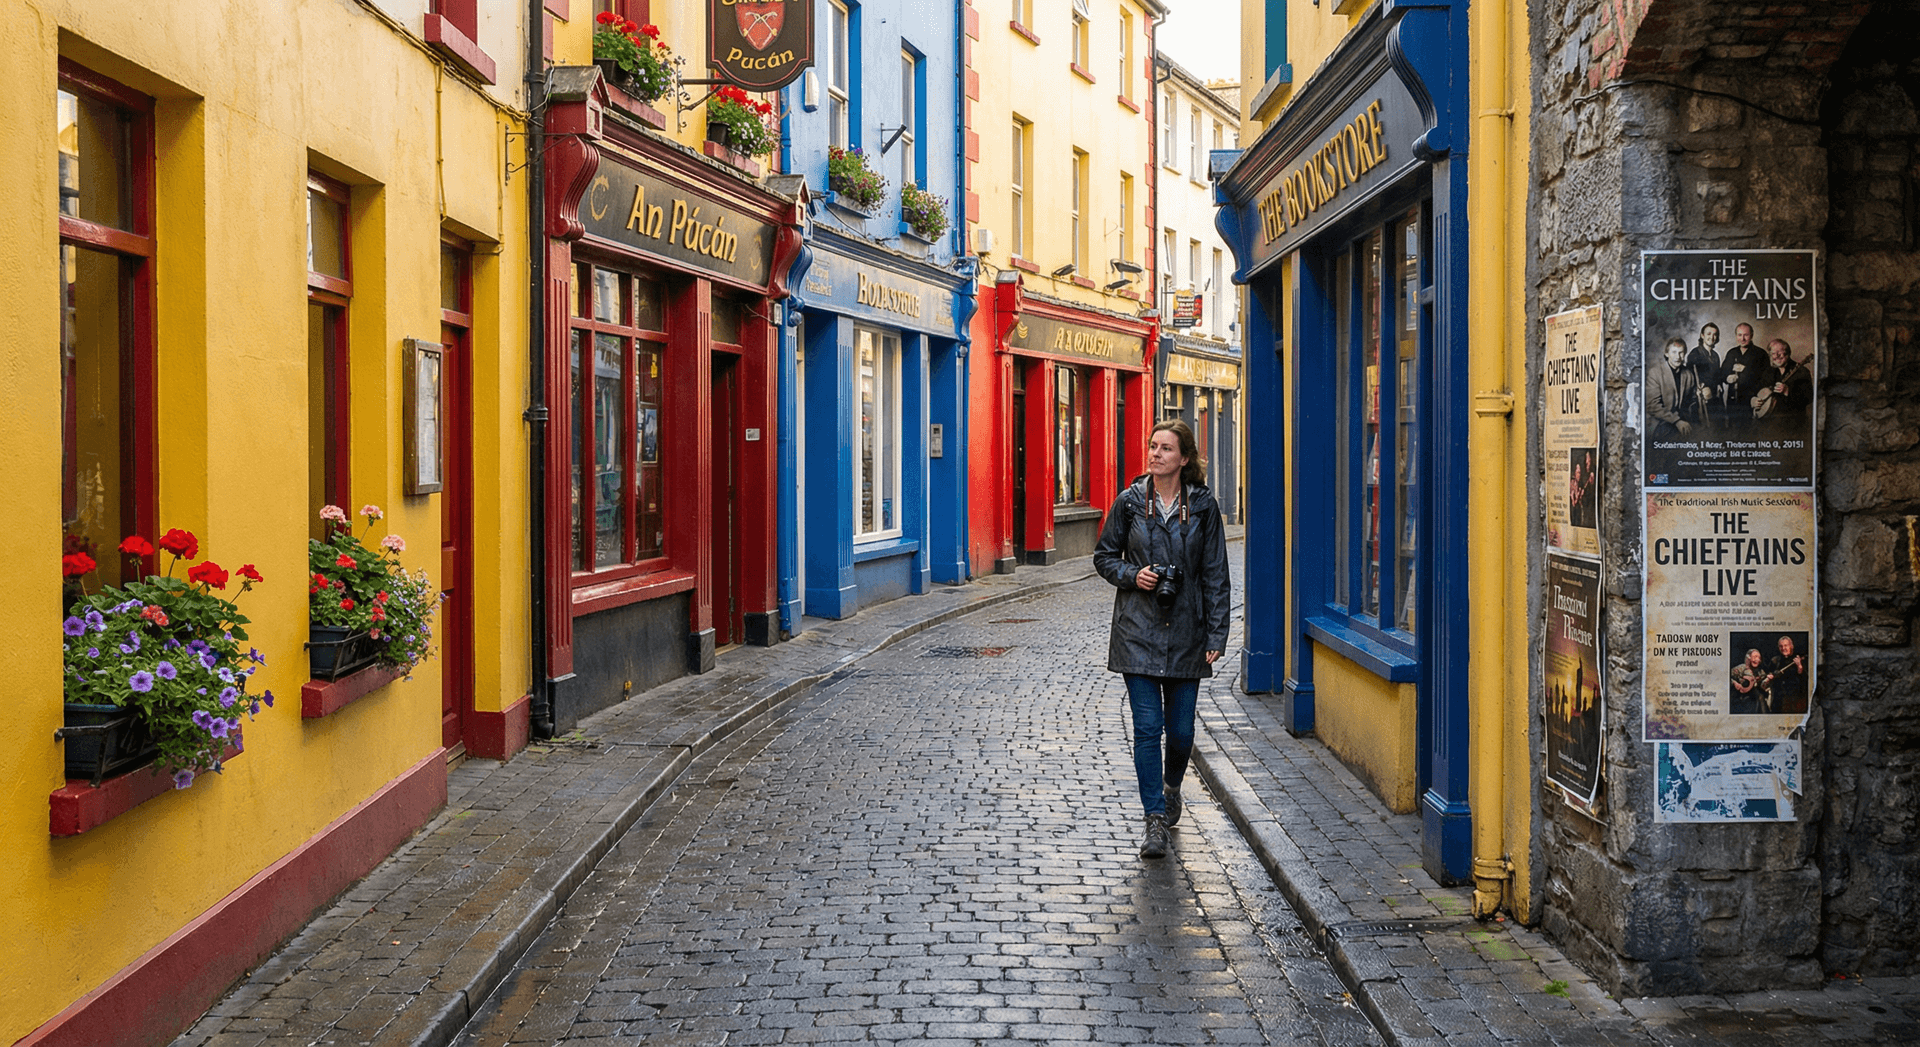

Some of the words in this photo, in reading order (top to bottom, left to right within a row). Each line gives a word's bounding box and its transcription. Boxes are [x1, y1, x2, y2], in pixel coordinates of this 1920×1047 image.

[1257, 186, 1287, 246] THE
[1283, 98, 1388, 228] BOOKSTORE
[626, 184, 664, 239] An
[669, 199, 738, 264] Púcán
[1709, 259, 1748, 276] THE
[1650, 278, 1806, 301] CHIEFTAINS
[1756, 303, 1798, 320] LIVE
[1565, 332, 1577, 354] THE
[1547, 354, 1596, 386] CHIEFTAINS
[1561, 388, 1580, 414] LIVE
[1675, 498, 1719, 506] traditional
[1721, 498, 1739, 506] Irish
[1740, 498, 1764, 506] Music
[1710, 513, 1749, 534] THE
[1654, 538, 1805, 565] CHIEFTAINS
[1703, 569, 1757, 596] LIVE
